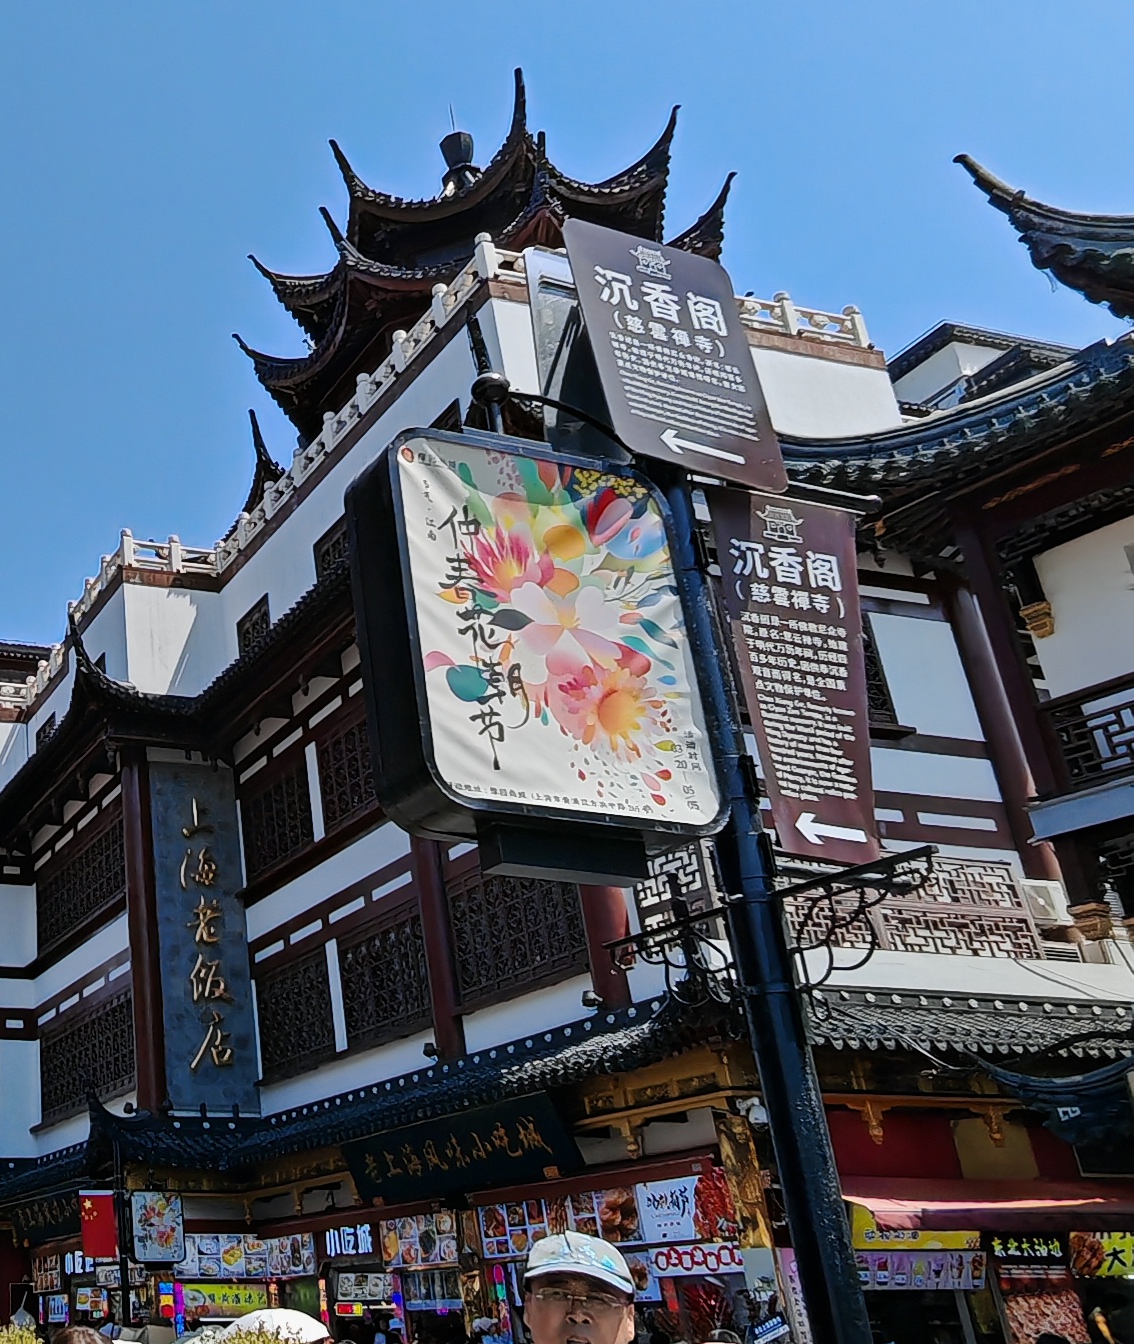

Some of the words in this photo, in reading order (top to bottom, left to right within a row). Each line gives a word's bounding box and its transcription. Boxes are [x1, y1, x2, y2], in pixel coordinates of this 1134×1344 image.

[593, 265, 728, 337] 沉香阁
[728, 538, 842, 592] 沉香阁
[436, 504, 530, 771] 仲春花朝节
[180, 796, 235, 1070] 上海老饭店
[364, 1115, 554, 1184] 老上海风味小吃城
[325, 1223, 373, 1258] 小吃城
